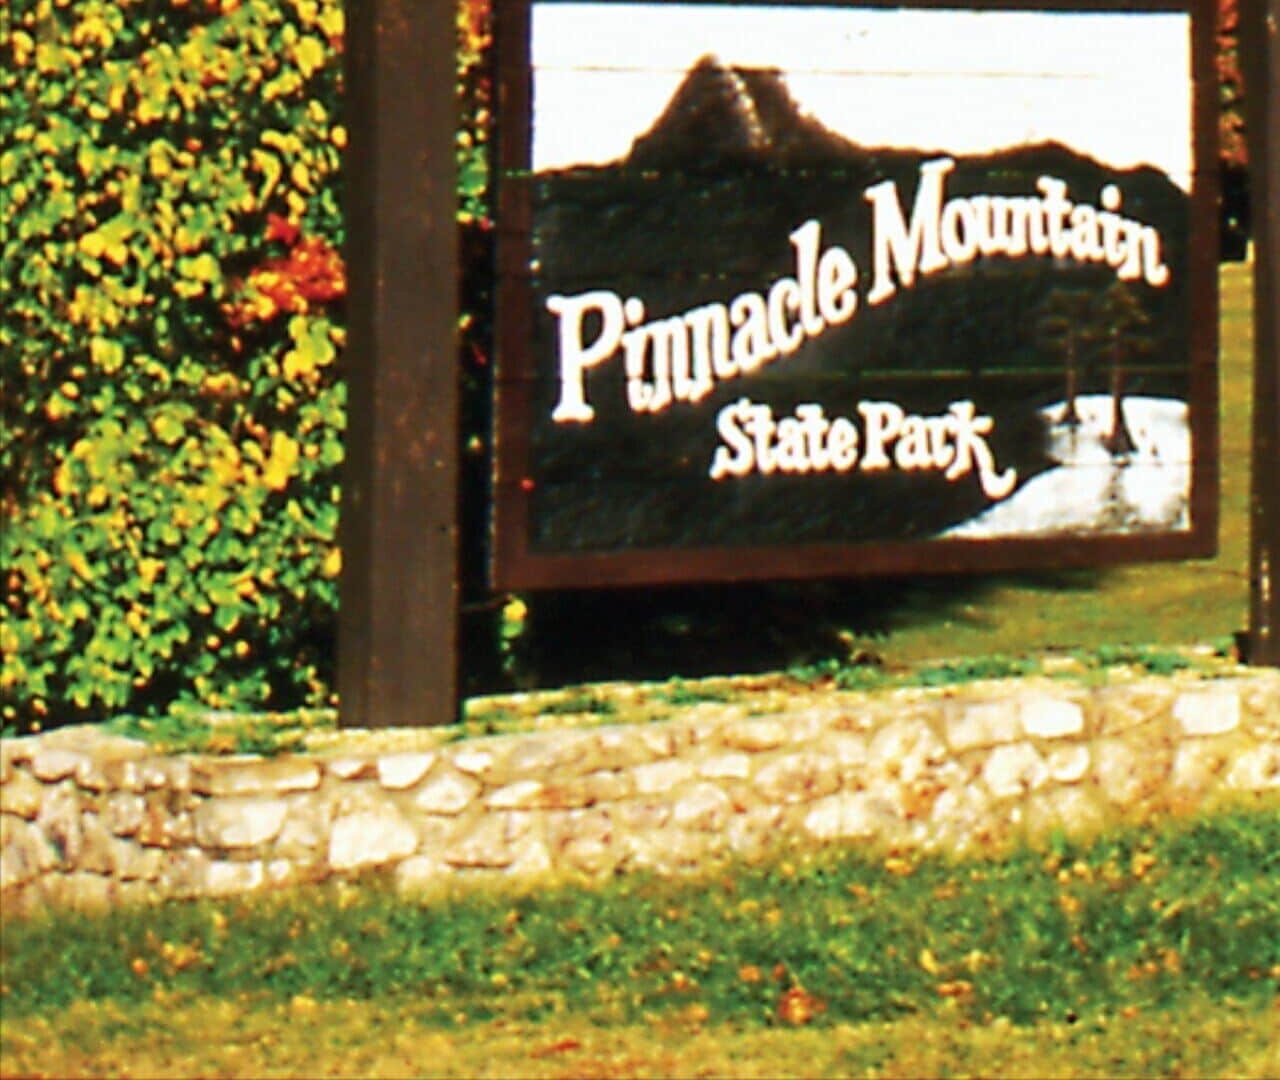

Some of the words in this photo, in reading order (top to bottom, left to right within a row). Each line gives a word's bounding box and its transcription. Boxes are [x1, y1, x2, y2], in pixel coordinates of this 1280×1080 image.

[546, 220, 857, 421] Pinnacle
[864, 157, 1168, 303] Mountain
[709, 398, 858, 478] State
[858, 401, 1016, 497] Park
